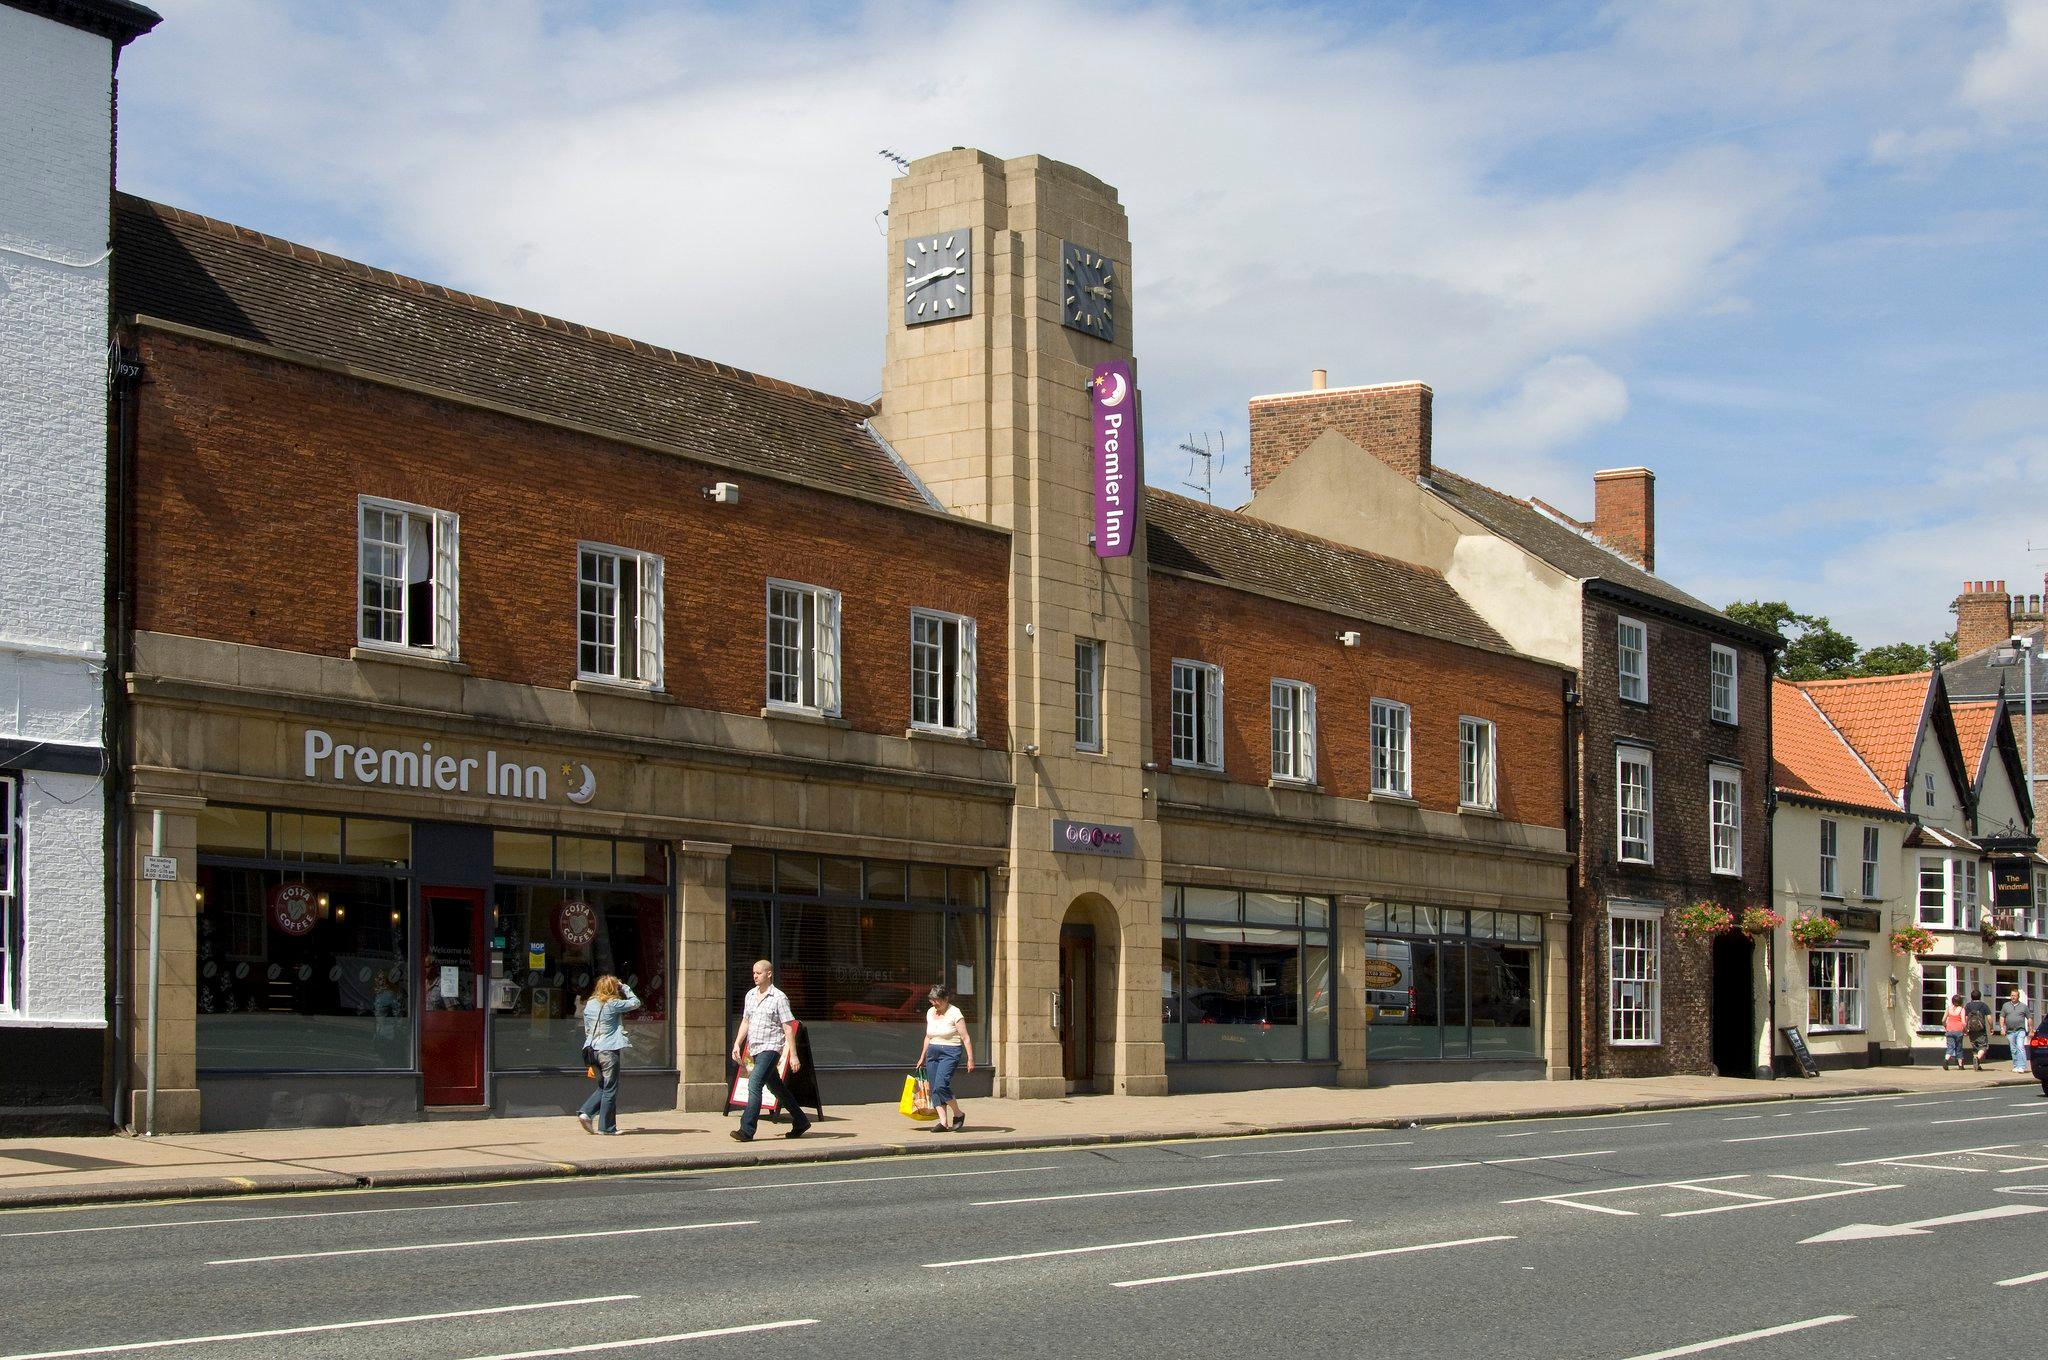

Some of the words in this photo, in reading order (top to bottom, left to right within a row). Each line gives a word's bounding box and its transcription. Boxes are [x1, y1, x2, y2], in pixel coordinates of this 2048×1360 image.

[120, 364, 139, 376] 1937
[1105, 413, 1123, 506] Premier
[1106, 510, 1124, 547] Inn
[304, 729, 478, 792] Premier
[487, 751, 547, 800] Inn
[282, 888, 310, 901] COSTA
[565, 904, 590, 916] COSTA
[280, 913, 313, 930] COFFEE
[564, 928, 593, 942] COFFEE
